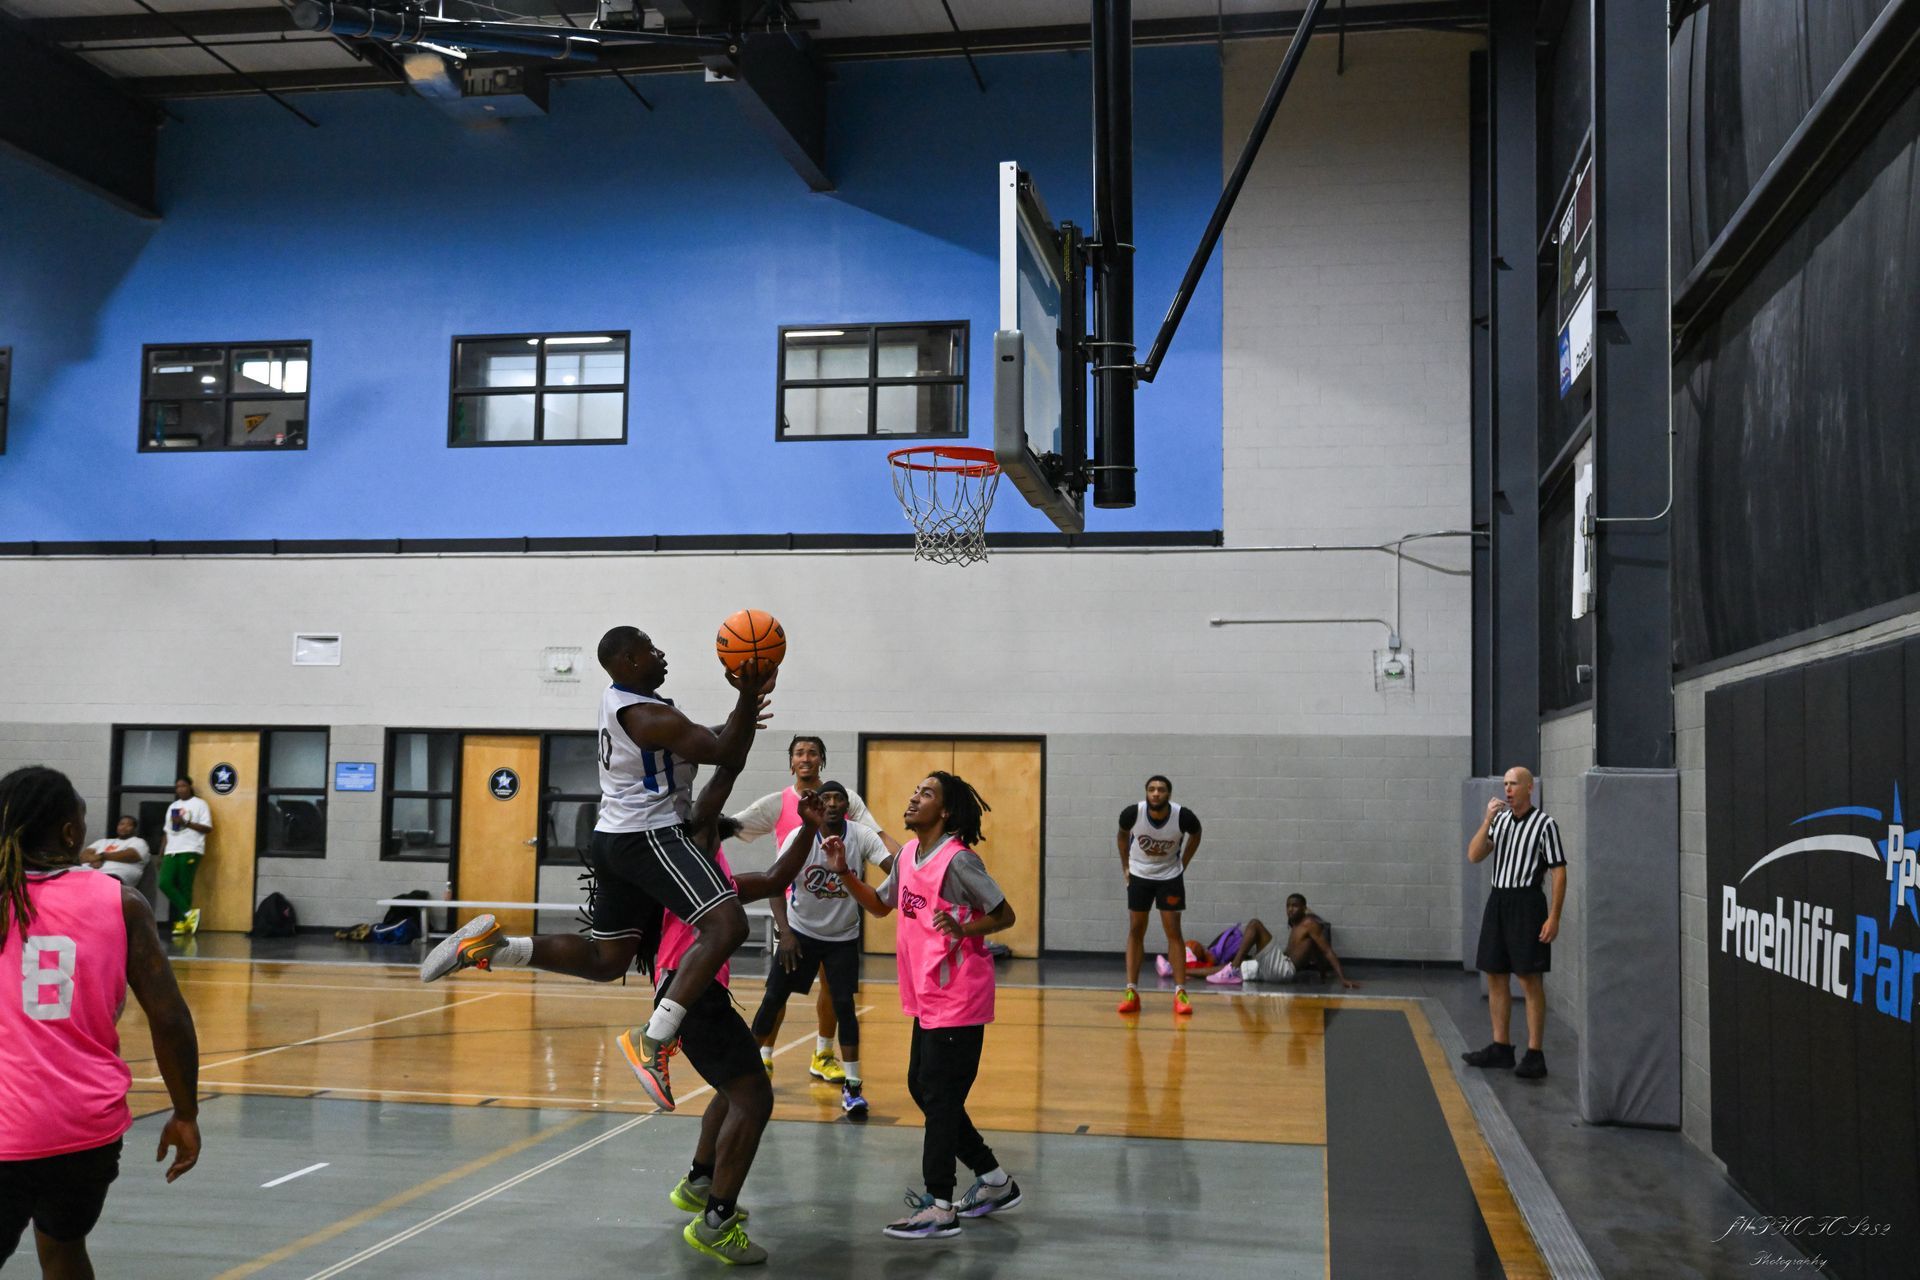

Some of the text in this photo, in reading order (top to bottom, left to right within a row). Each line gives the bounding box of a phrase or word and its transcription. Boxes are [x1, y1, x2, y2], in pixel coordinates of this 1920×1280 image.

[22, 935, 76, 1020] 8
[1721, 884, 1920, 1024] Proehlific Par
